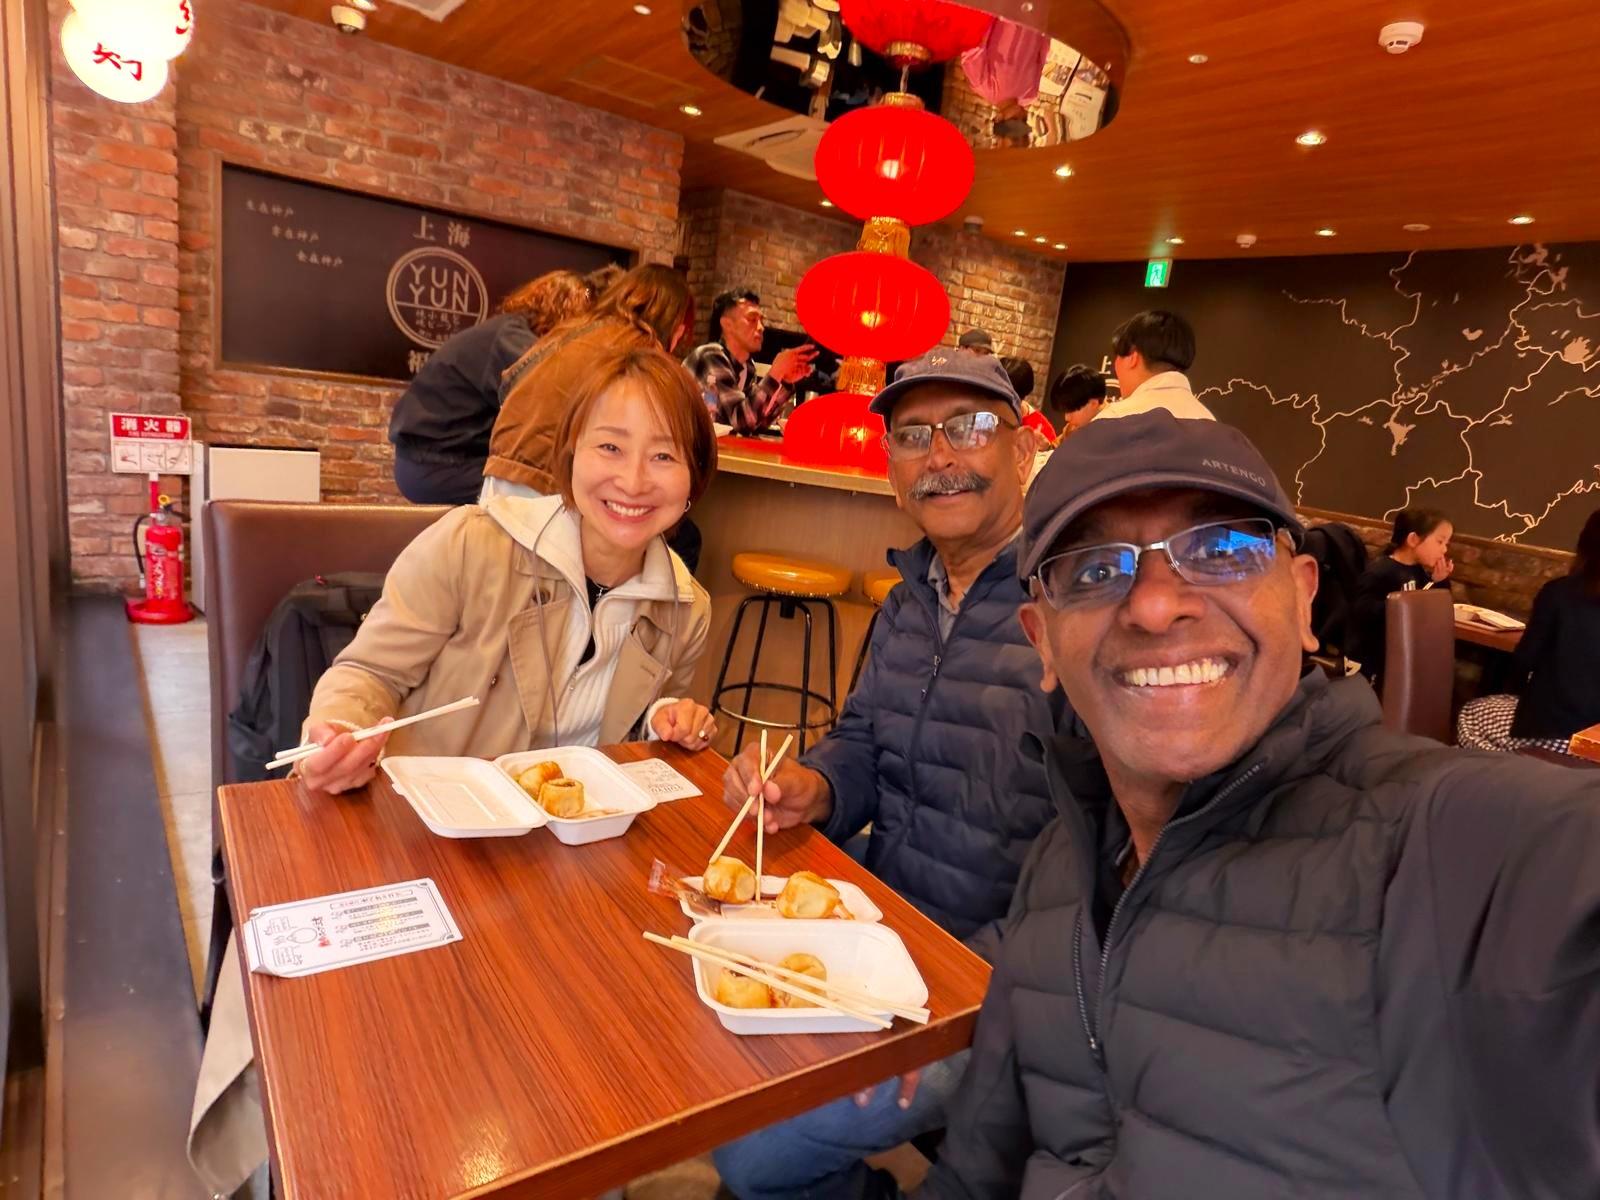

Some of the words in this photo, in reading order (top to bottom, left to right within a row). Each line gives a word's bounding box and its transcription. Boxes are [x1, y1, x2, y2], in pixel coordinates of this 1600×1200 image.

[412, 216, 471, 248] 上海
[409, 262, 470, 295] YUN
[409, 283, 468, 314] YUN
[1201, 458, 1266, 487] ARTENGO
